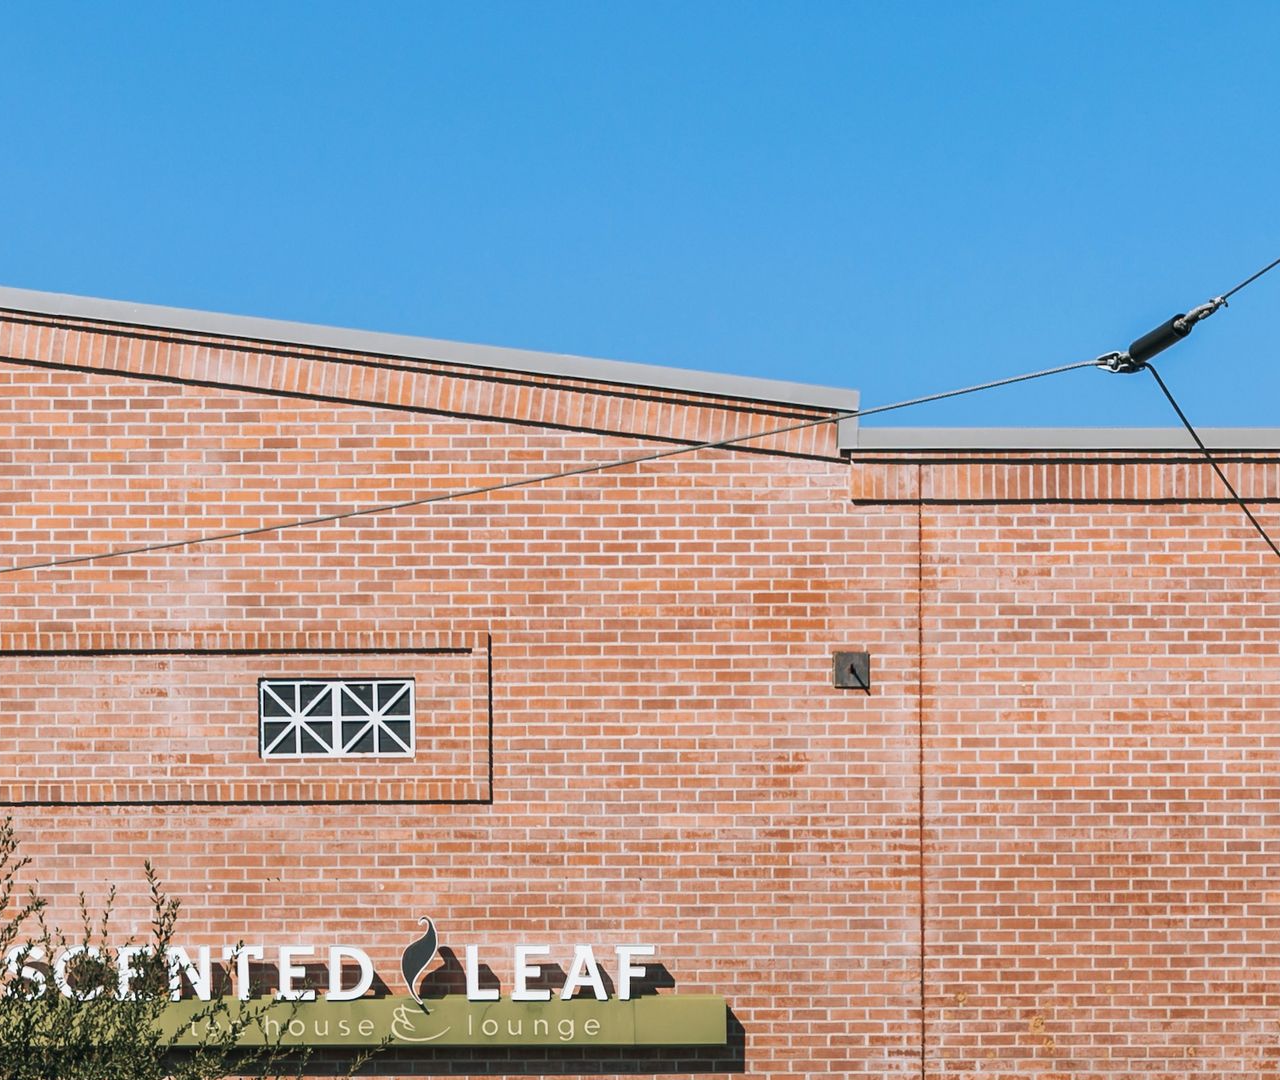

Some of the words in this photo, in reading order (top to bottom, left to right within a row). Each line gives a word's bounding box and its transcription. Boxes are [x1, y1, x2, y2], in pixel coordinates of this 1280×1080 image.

[6, 944, 374, 1002] SCENTED
[466, 943, 656, 1001] LEAF
[264, 1014, 375, 1038] house
[468, 1014, 602, 1041] lounge
